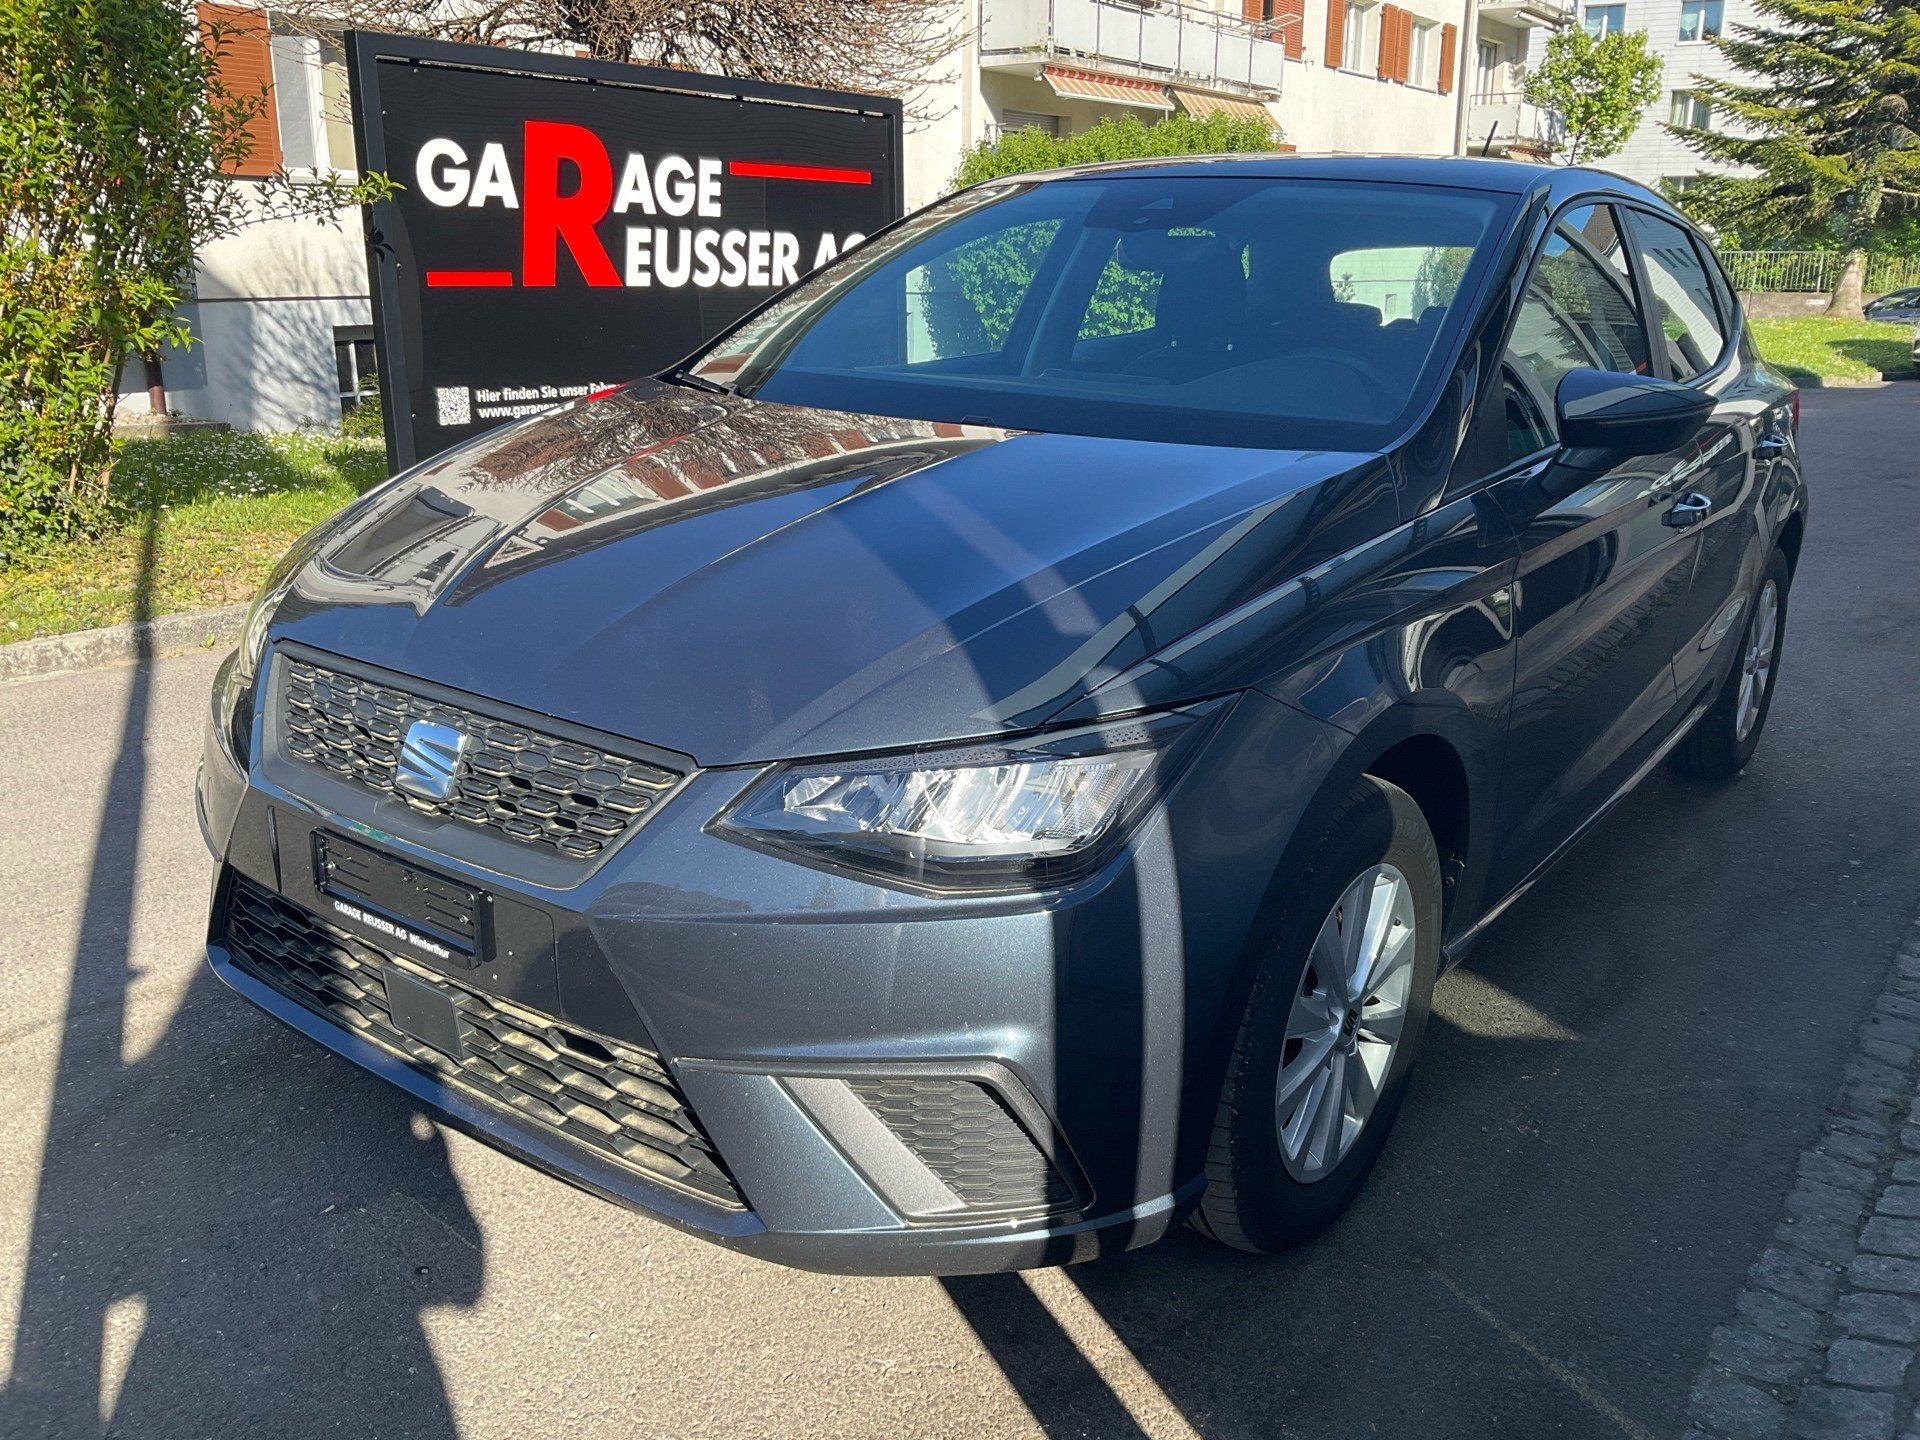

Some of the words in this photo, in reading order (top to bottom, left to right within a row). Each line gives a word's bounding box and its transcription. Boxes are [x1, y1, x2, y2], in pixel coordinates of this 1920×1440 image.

[476, 388, 501, 402] Hier
[502, 386, 540, 401] finden
[541, 385, 558, 399] Sie
[559, 386, 588, 397] unser
[334, 900, 362, 920] GARAGE
[363, 912, 395, 936] REUSSER
[395, 926, 408, 940] AG
[409, 932, 450, 959] Winterthur
